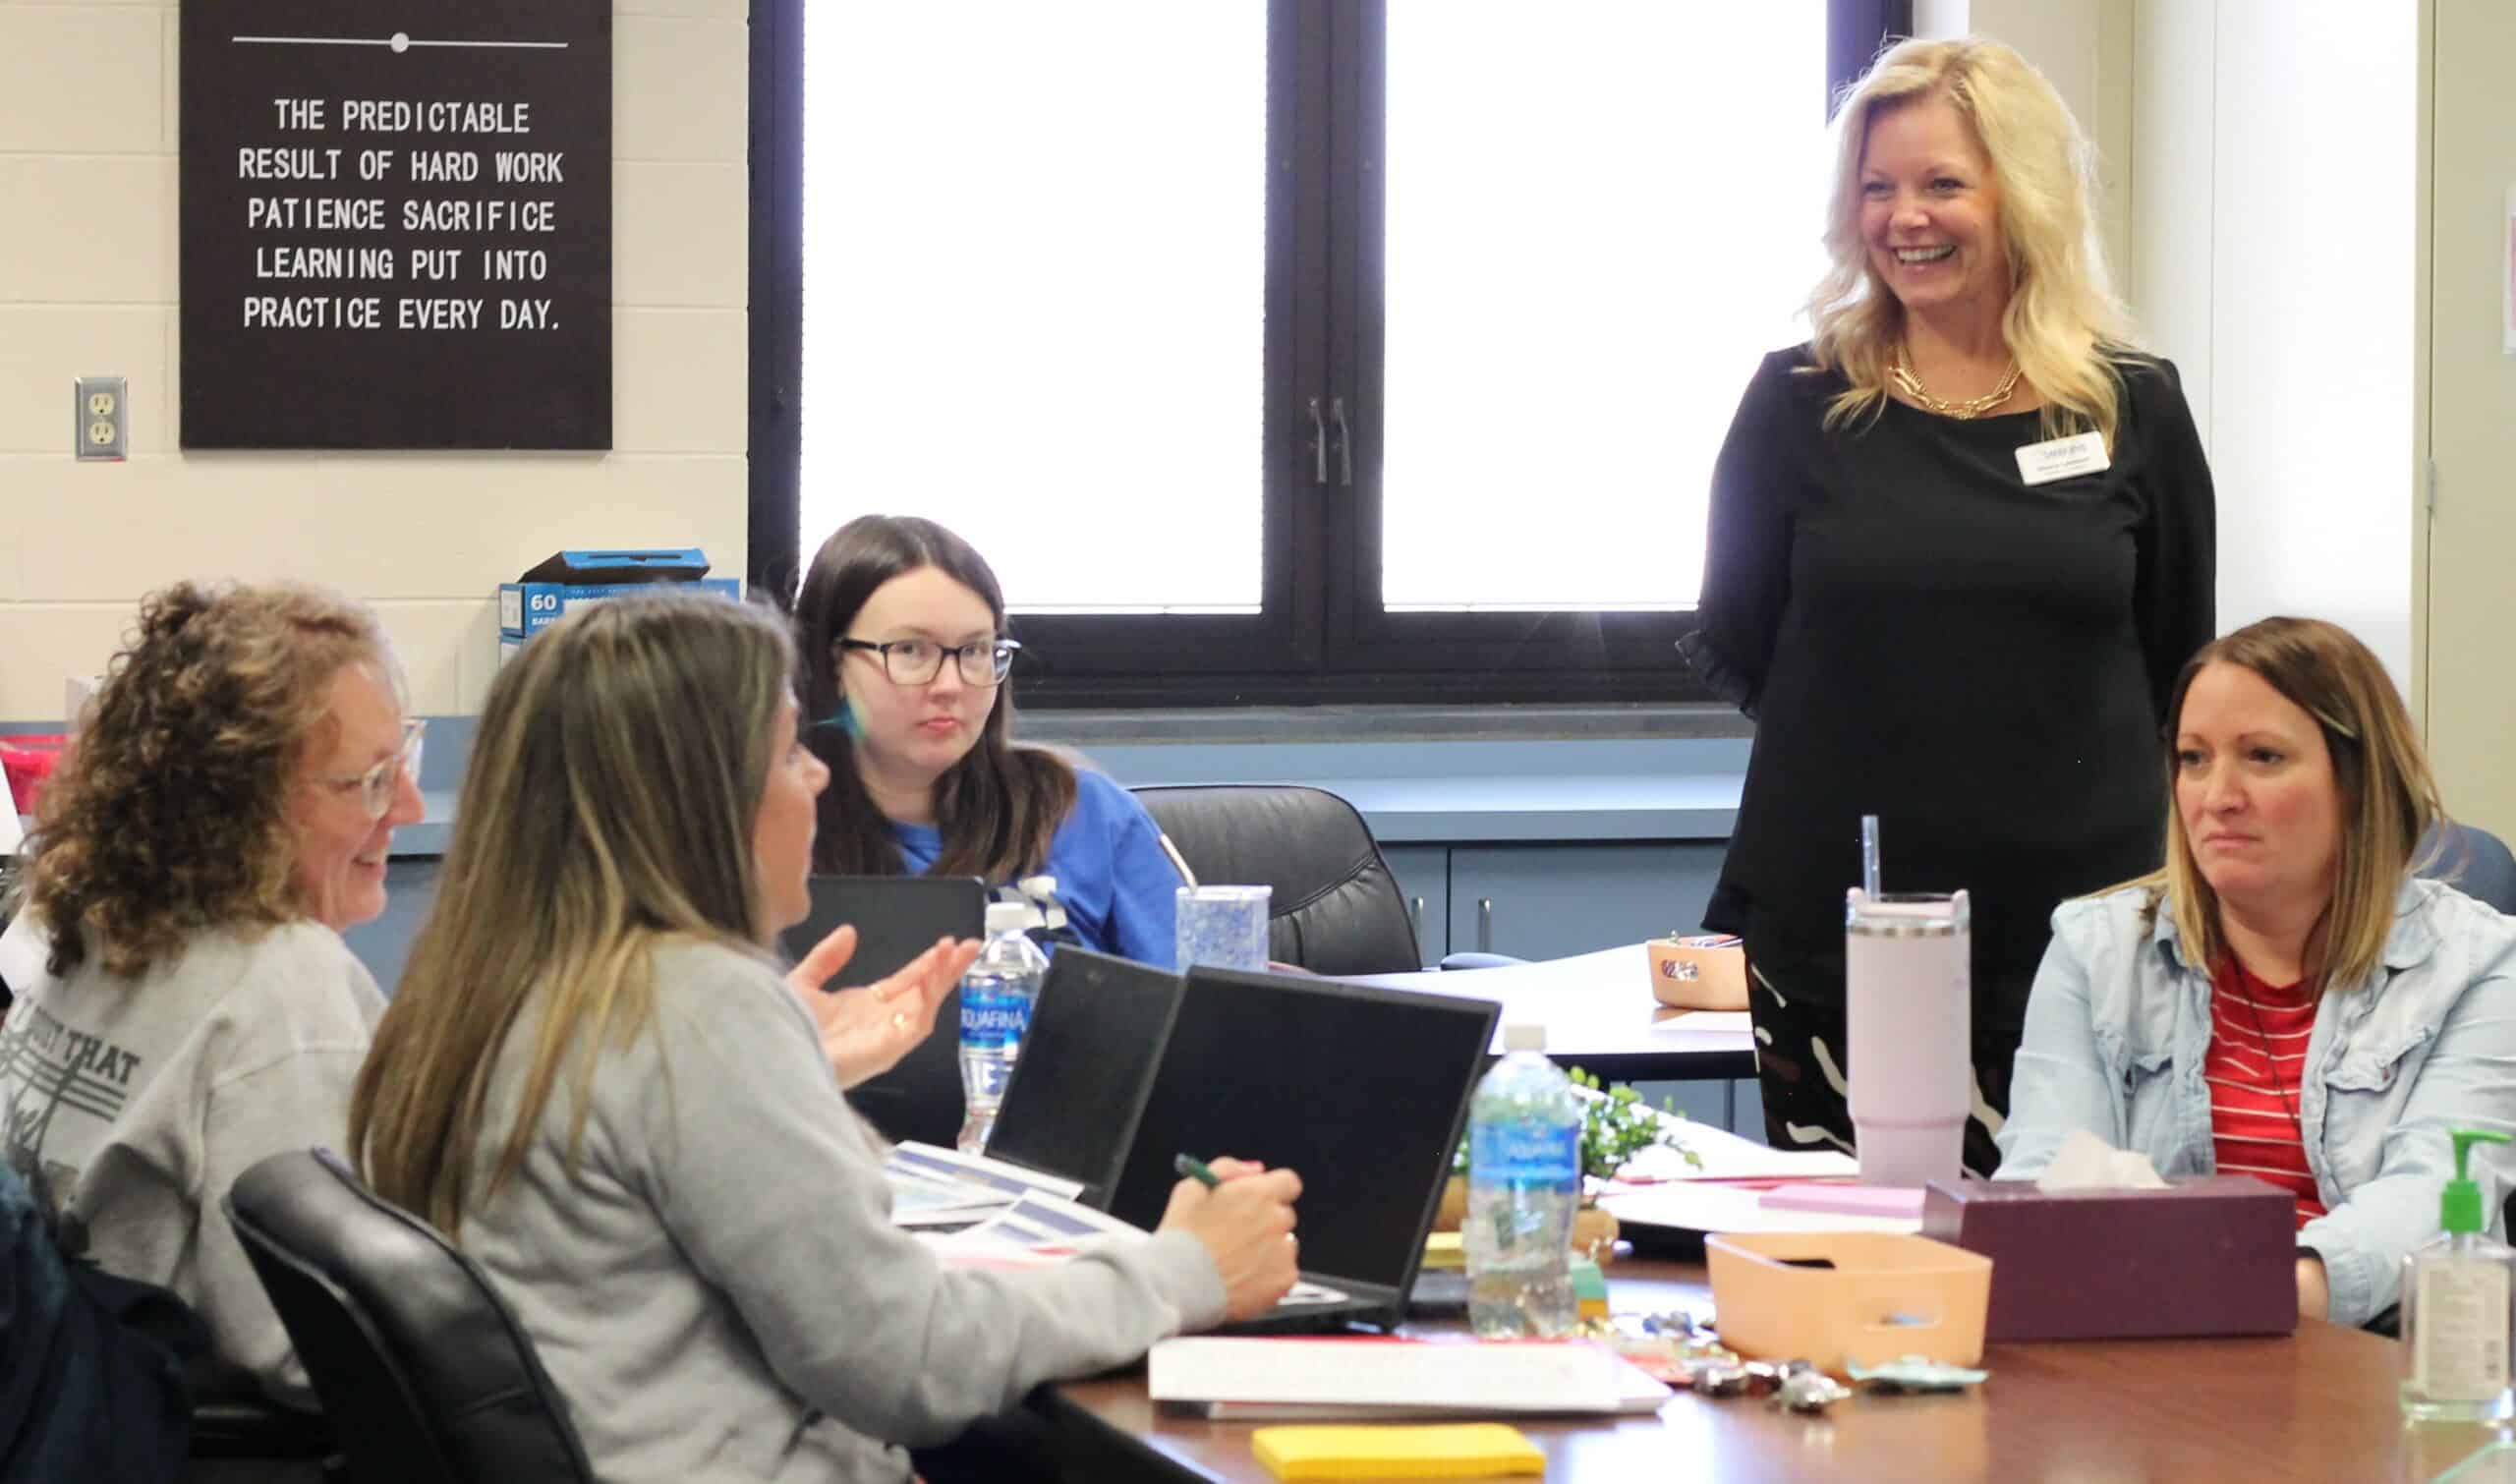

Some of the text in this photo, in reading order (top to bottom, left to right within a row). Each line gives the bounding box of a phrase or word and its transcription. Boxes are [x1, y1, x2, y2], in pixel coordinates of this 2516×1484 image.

[274, 98, 531, 134] THE PREDICTABLE
[238, 147, 564, 183] RESULT OF HARD WORK
[248, 198, 555, 232] PATIENCE SACRIFICE
[257, 247, 546, 281] LEARNING PUT INTO
[244, 297, 559, 330] PRACTICE EVERY DAY.
[531, 594, 557, 610] 60
[64, 1030, 141, 1084] THAT
